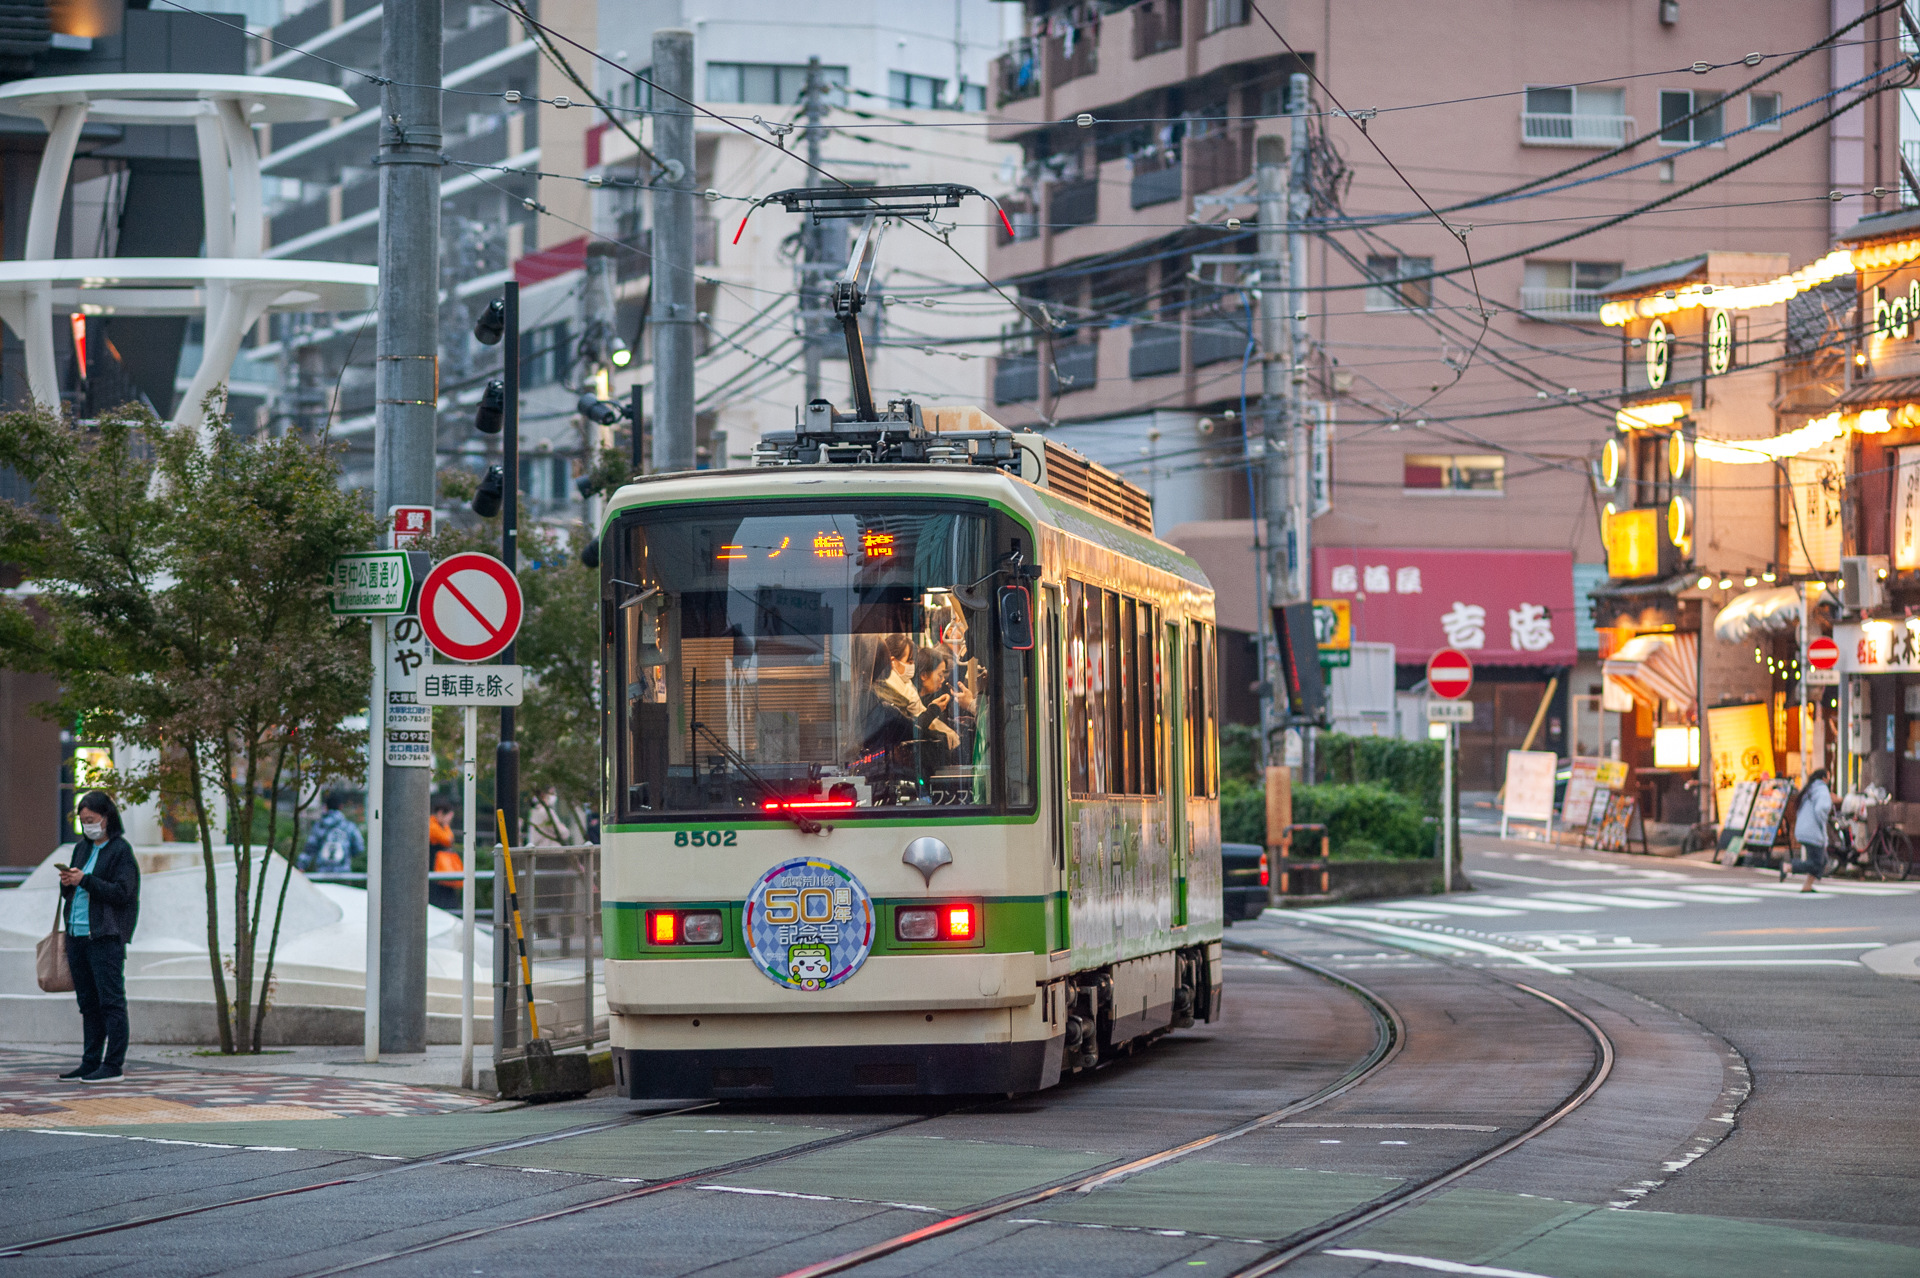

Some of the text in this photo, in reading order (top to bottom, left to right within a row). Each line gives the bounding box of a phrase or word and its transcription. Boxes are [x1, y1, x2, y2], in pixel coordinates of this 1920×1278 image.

[407, 512, 425, 530] 質
[1331, 564, 1423, 594] 居酒屋
[425, 674, 514, 697] 自転車を除く
[931, 789, 981, 806] ワンマン
[673, 830, 738, 848] 8502
[781, 875, 835, 887] 都電荒川線
[779, 924, 839, 945] 記念号
